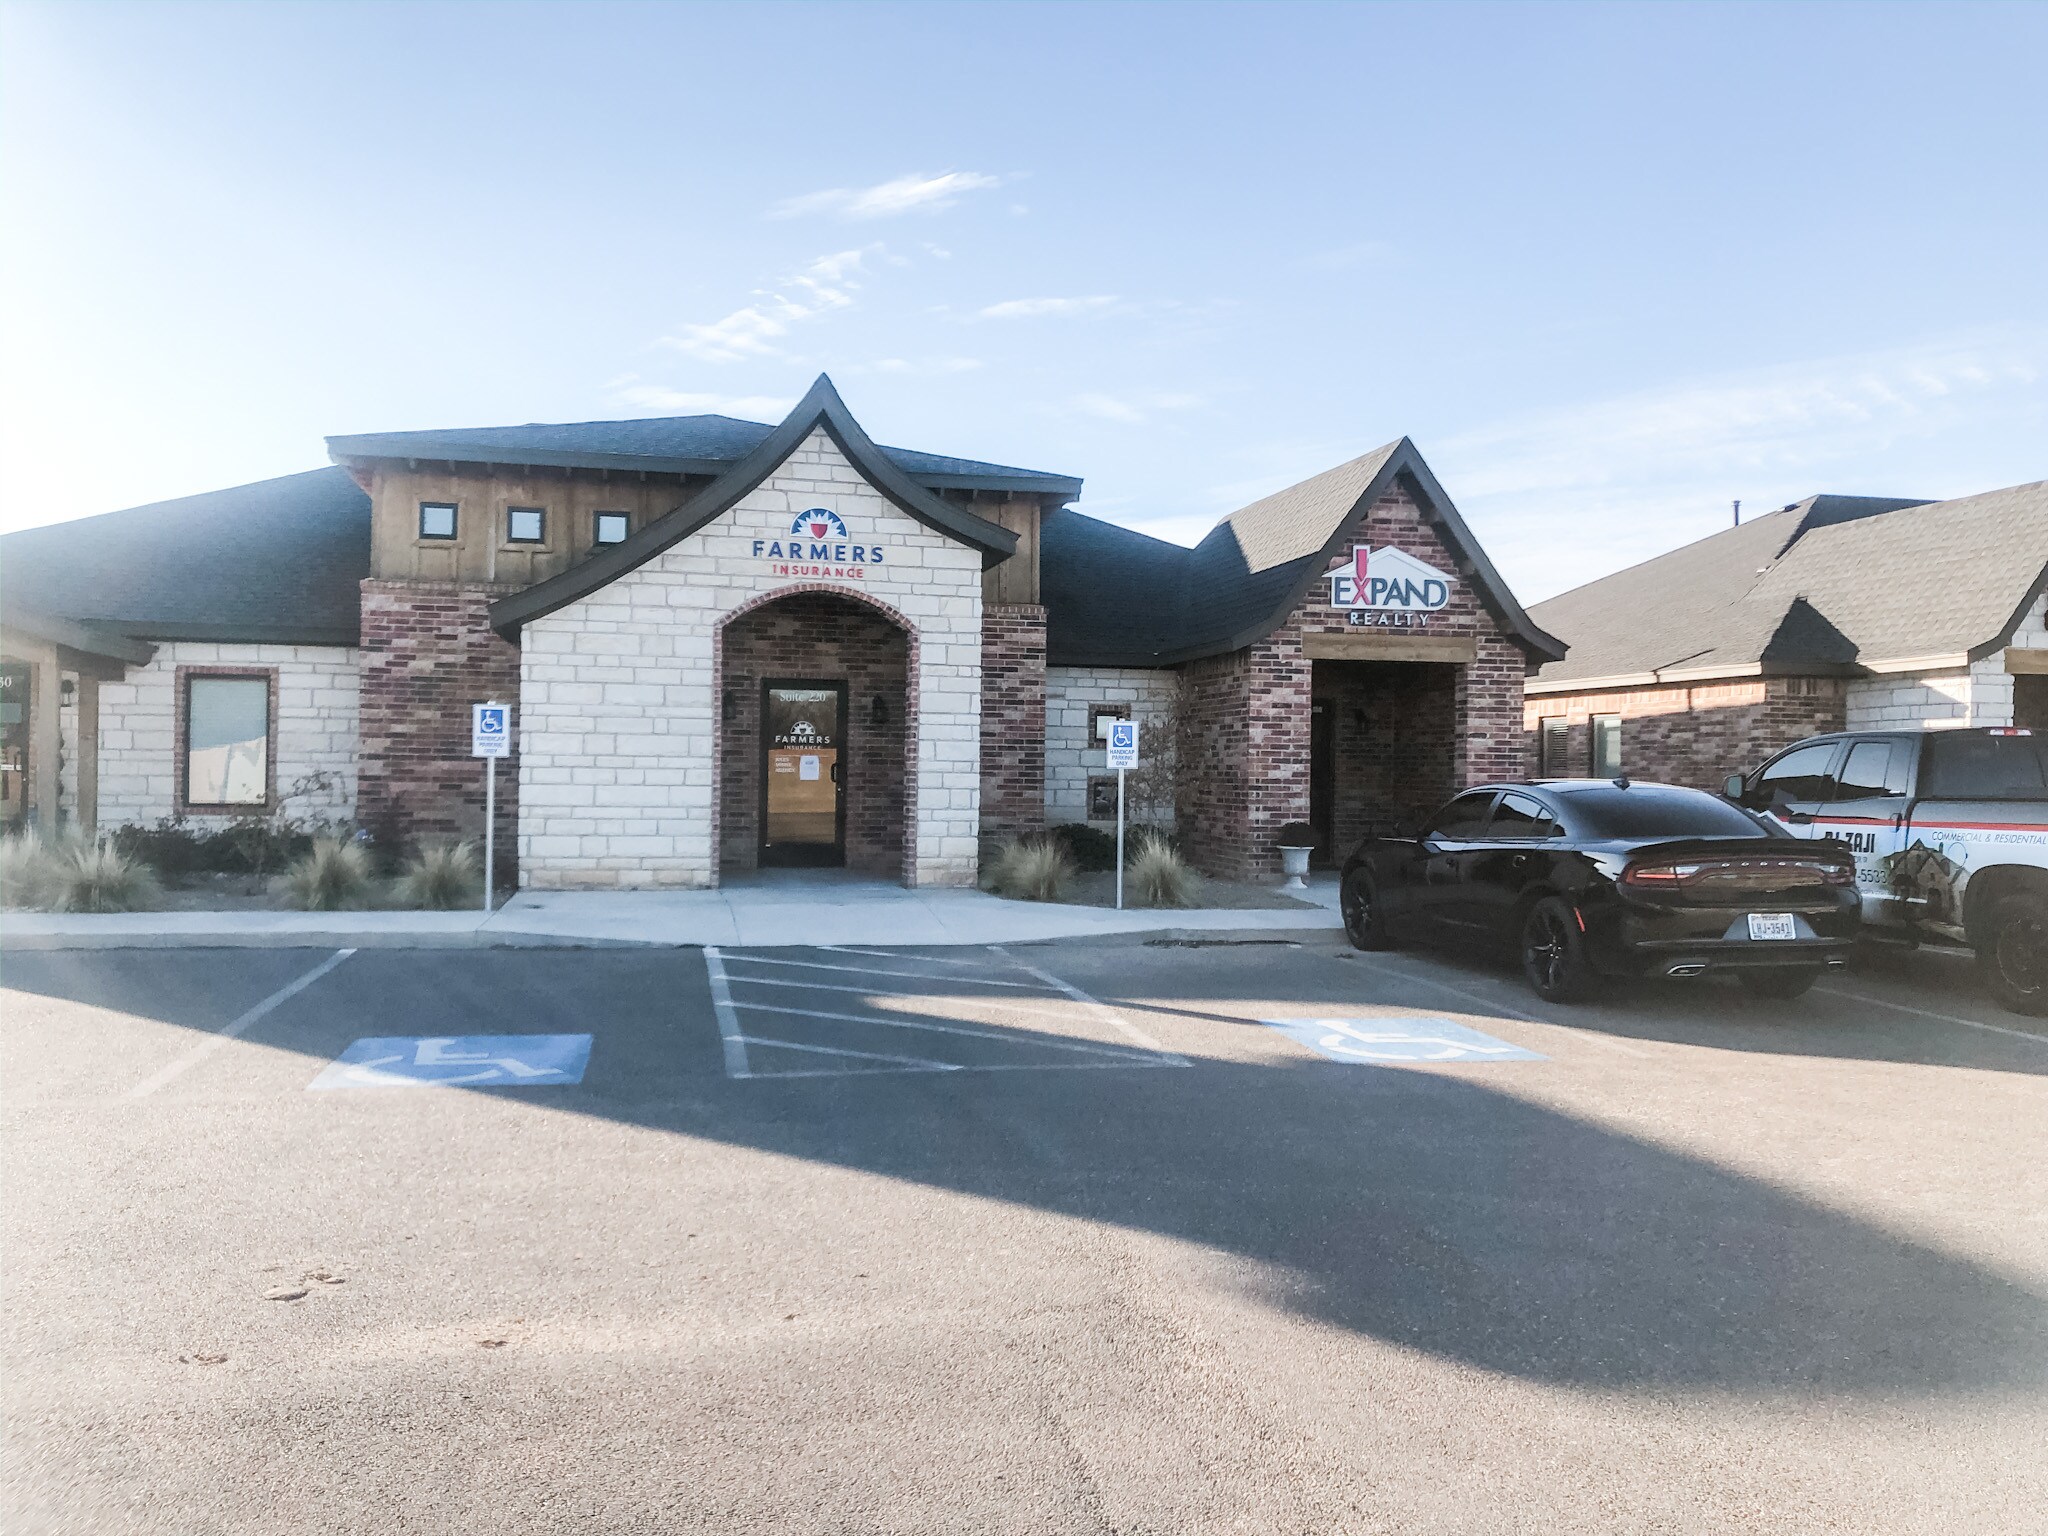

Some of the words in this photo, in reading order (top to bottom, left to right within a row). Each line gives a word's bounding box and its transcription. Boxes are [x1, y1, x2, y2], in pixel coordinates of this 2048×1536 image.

[753, 541, 883, 563] FARMERS
[772, 564, 864, 578] INSURANCE
[1335, 577, 1447, 607] EXPAND
[1350, 612, 1429, 626] REALTY
[780, 692, 804, 702] Suite
[808, 691, 826, 702] 220
[775, 735, 831, 744] FARMERS
[1931, 831, 1982, 842] COMMERCIAL
[1986, 833, 1991, 843] &
[1995, 834, 2048, 845] RESIDENTIAL
